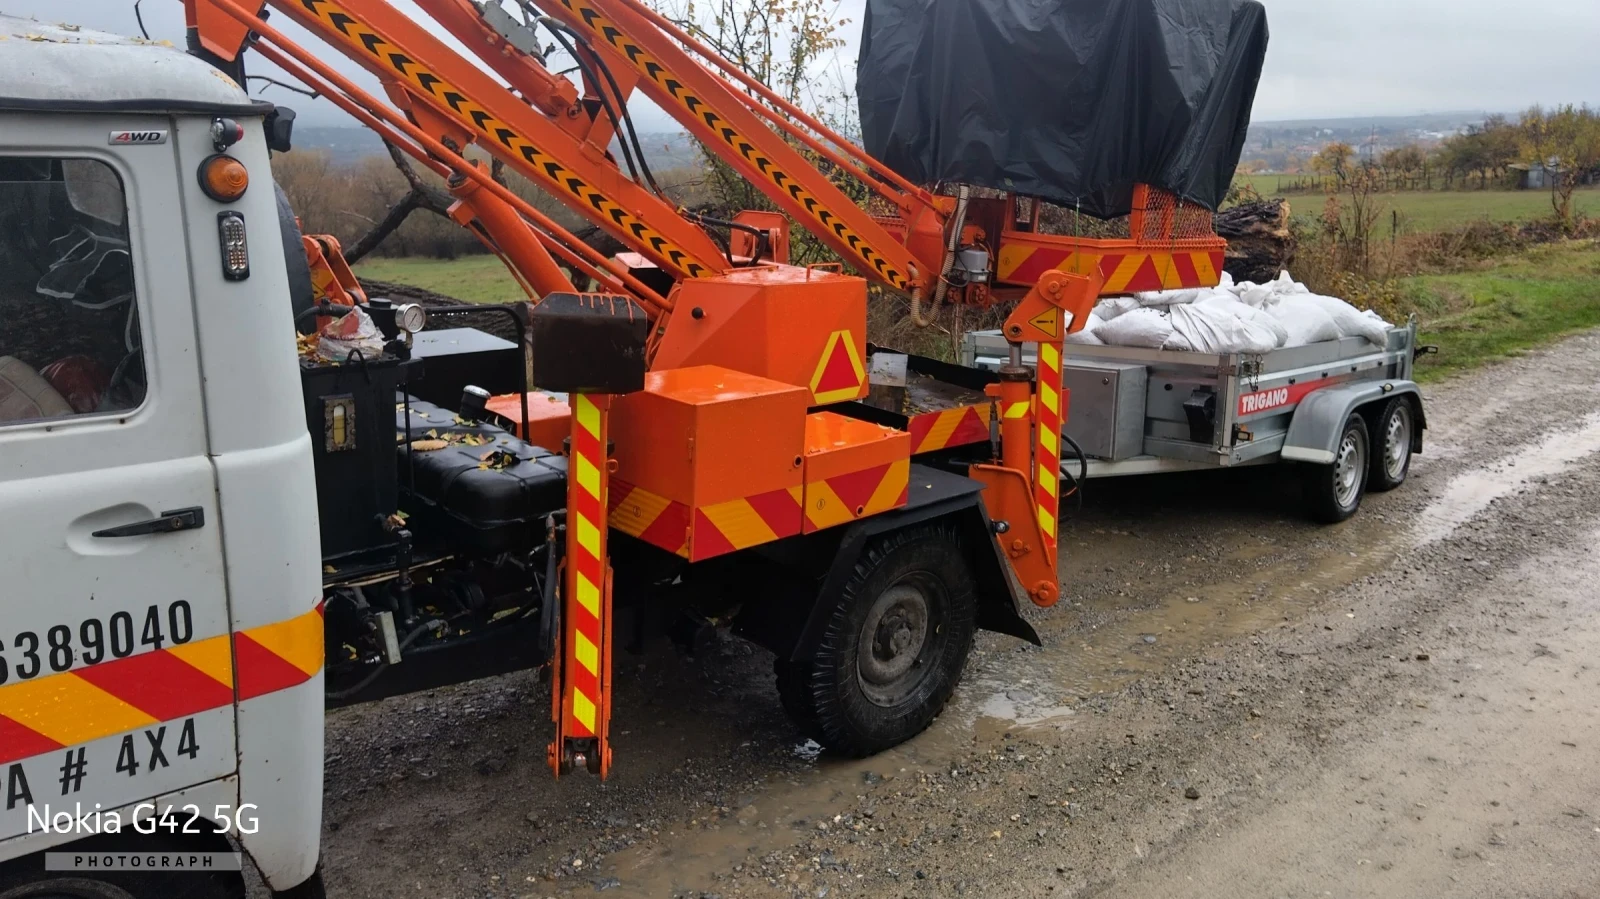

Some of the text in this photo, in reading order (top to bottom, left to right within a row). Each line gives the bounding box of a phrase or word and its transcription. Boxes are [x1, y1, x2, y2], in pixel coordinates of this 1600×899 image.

[115, 132, 161, 142] 4WD
[1242, 388, 1288, 413] TRIGANO
[0, 762, 34, 811] A
[115, 718, 200, 777] 4X4
